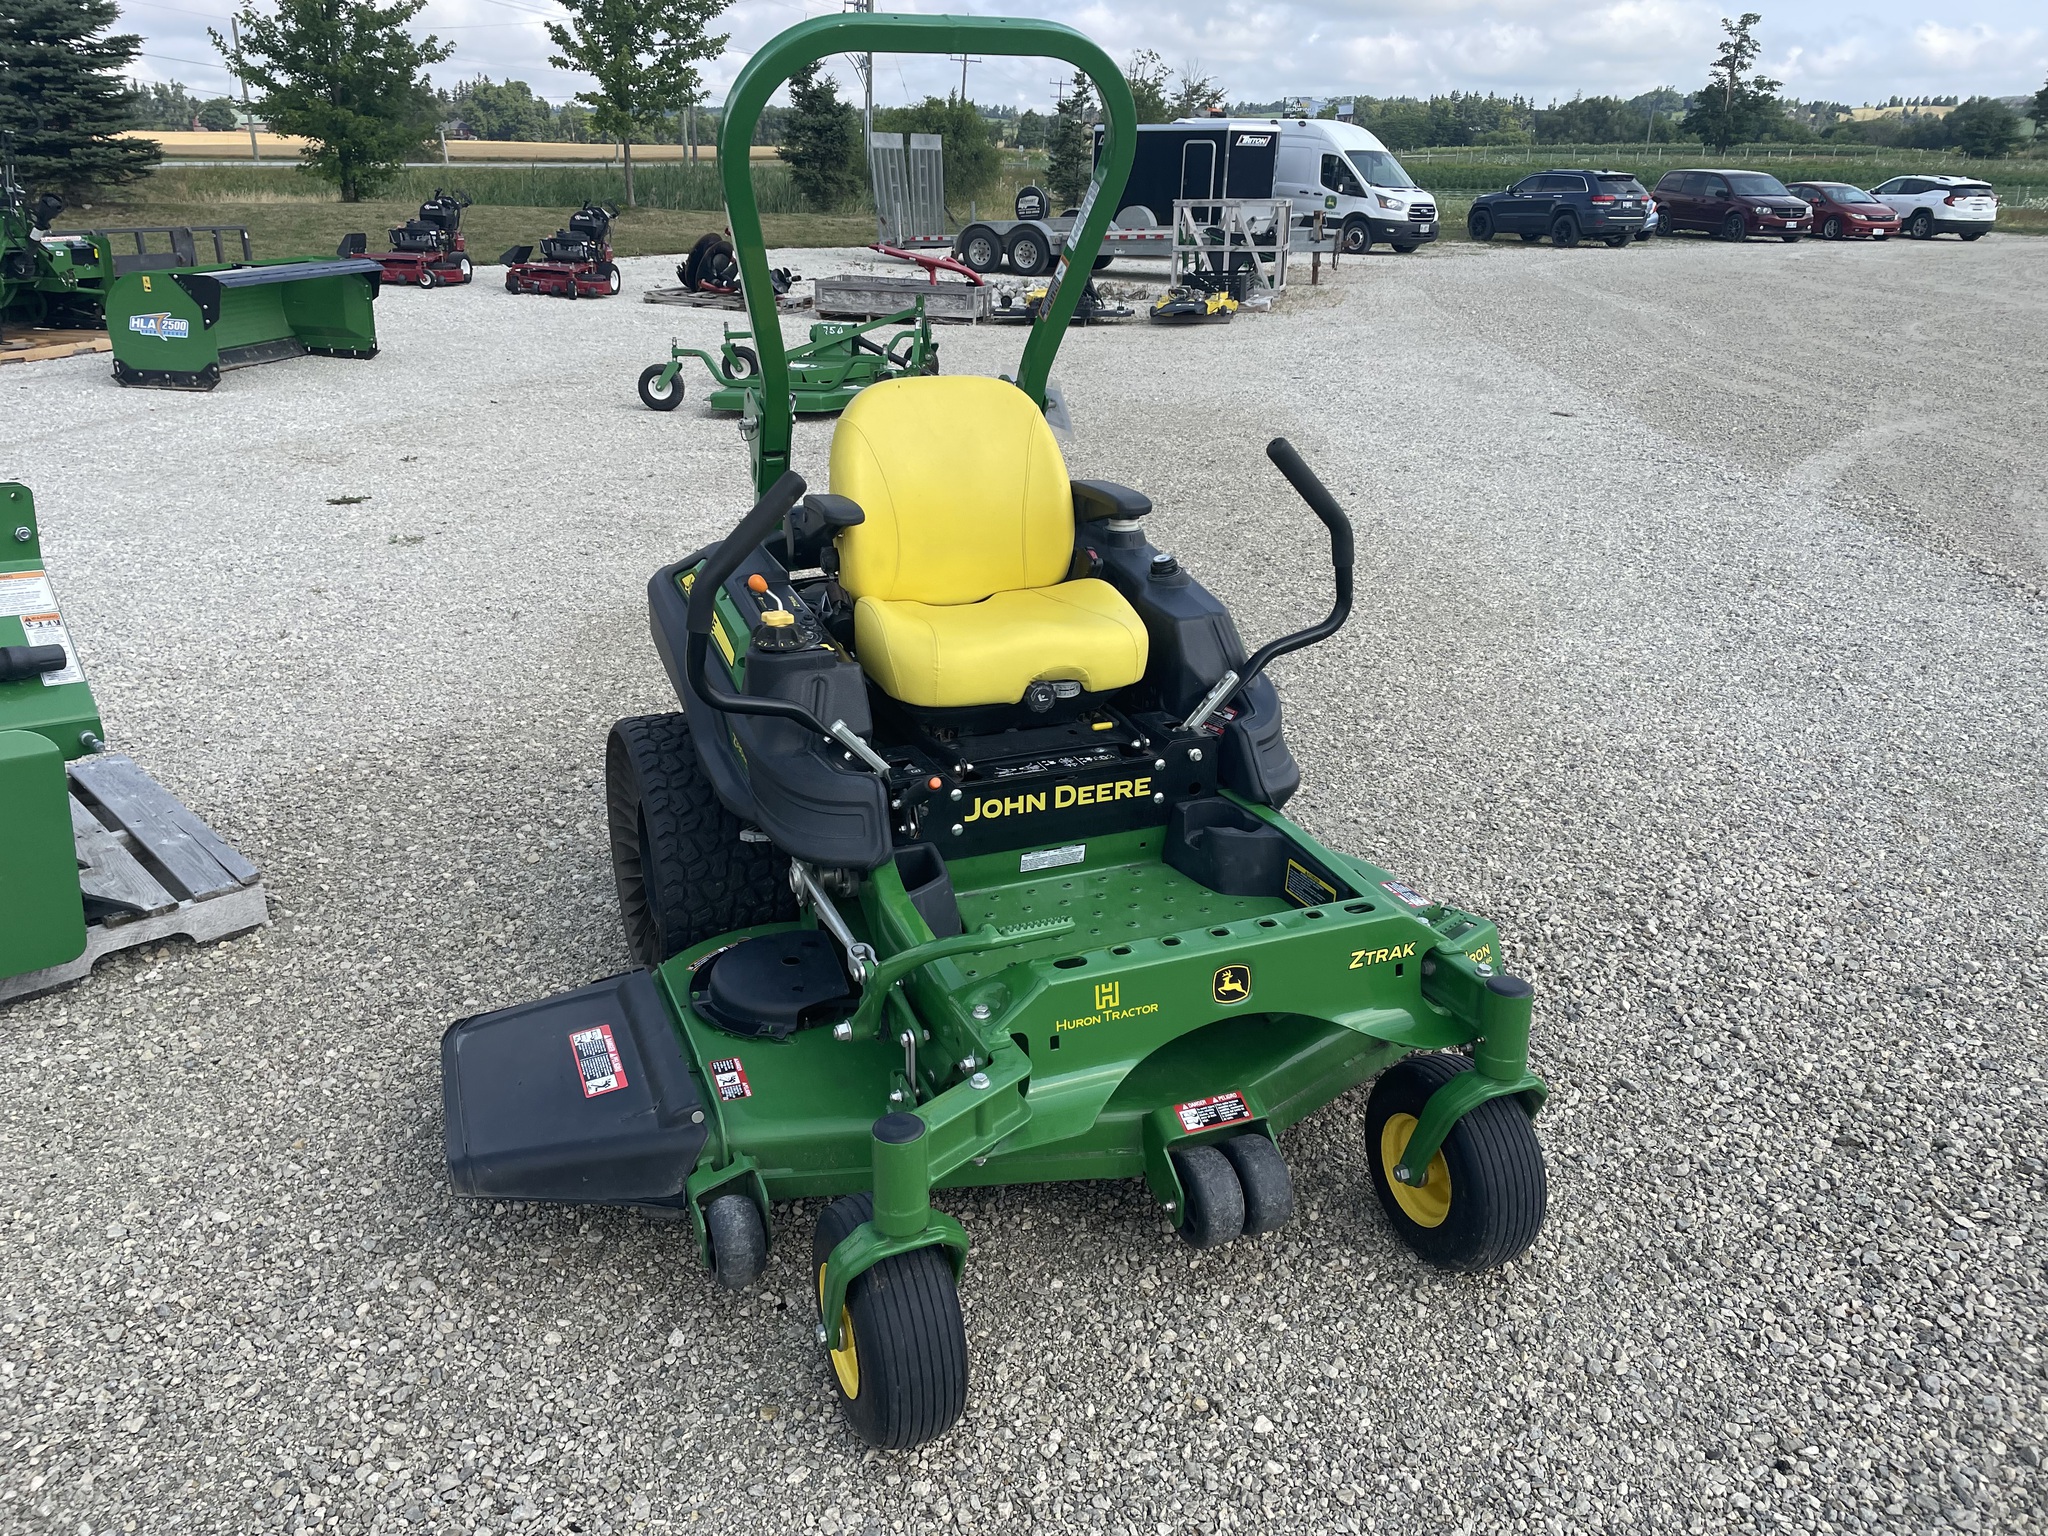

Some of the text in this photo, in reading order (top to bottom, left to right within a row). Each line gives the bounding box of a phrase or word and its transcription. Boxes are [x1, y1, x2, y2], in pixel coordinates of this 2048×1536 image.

[131, 317, 187, 331] HLA 2500
[964, 777, 1152, 822] JOHN DEERE
[1349, 941, 1416, 970] ZTRAK
[1056, 1003, 1158, 1032] HURON TRACTOR
[1188, 1093, 1237, 1108] DANGER PELIGRO
